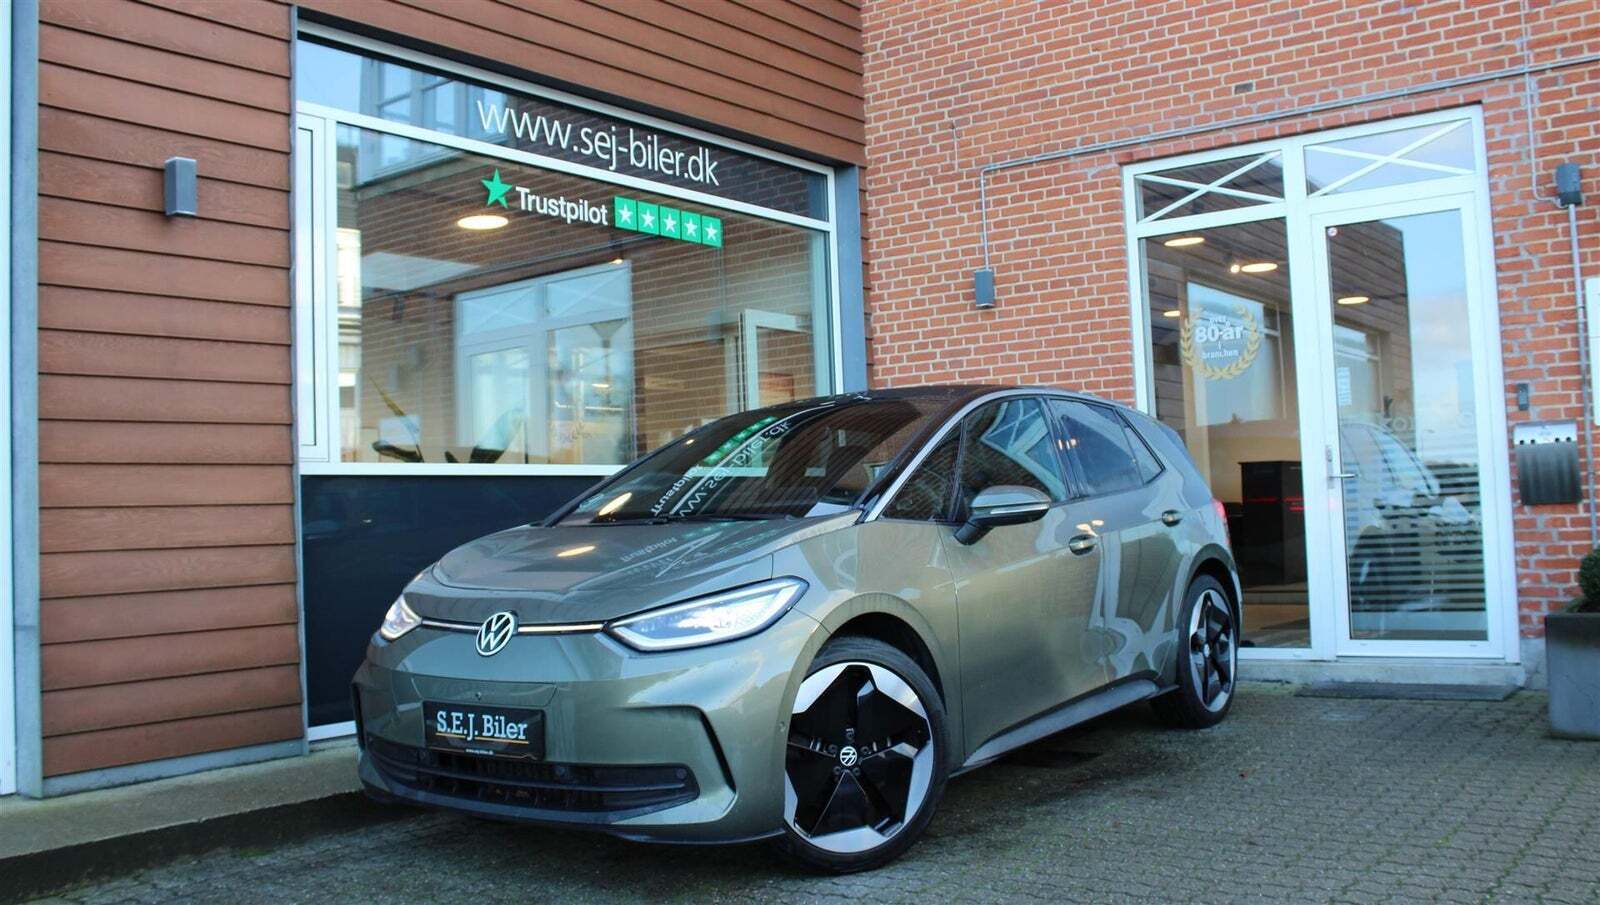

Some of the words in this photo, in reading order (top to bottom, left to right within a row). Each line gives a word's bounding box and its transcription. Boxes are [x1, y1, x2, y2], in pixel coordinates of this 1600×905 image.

[477, 101, 719, 186] www.sej-biler.dk
[516, 187, 608, 226] Trustpilot
[436, 710, 478, 741] S.E.J.
[482, 714, 528, 740] Biler
